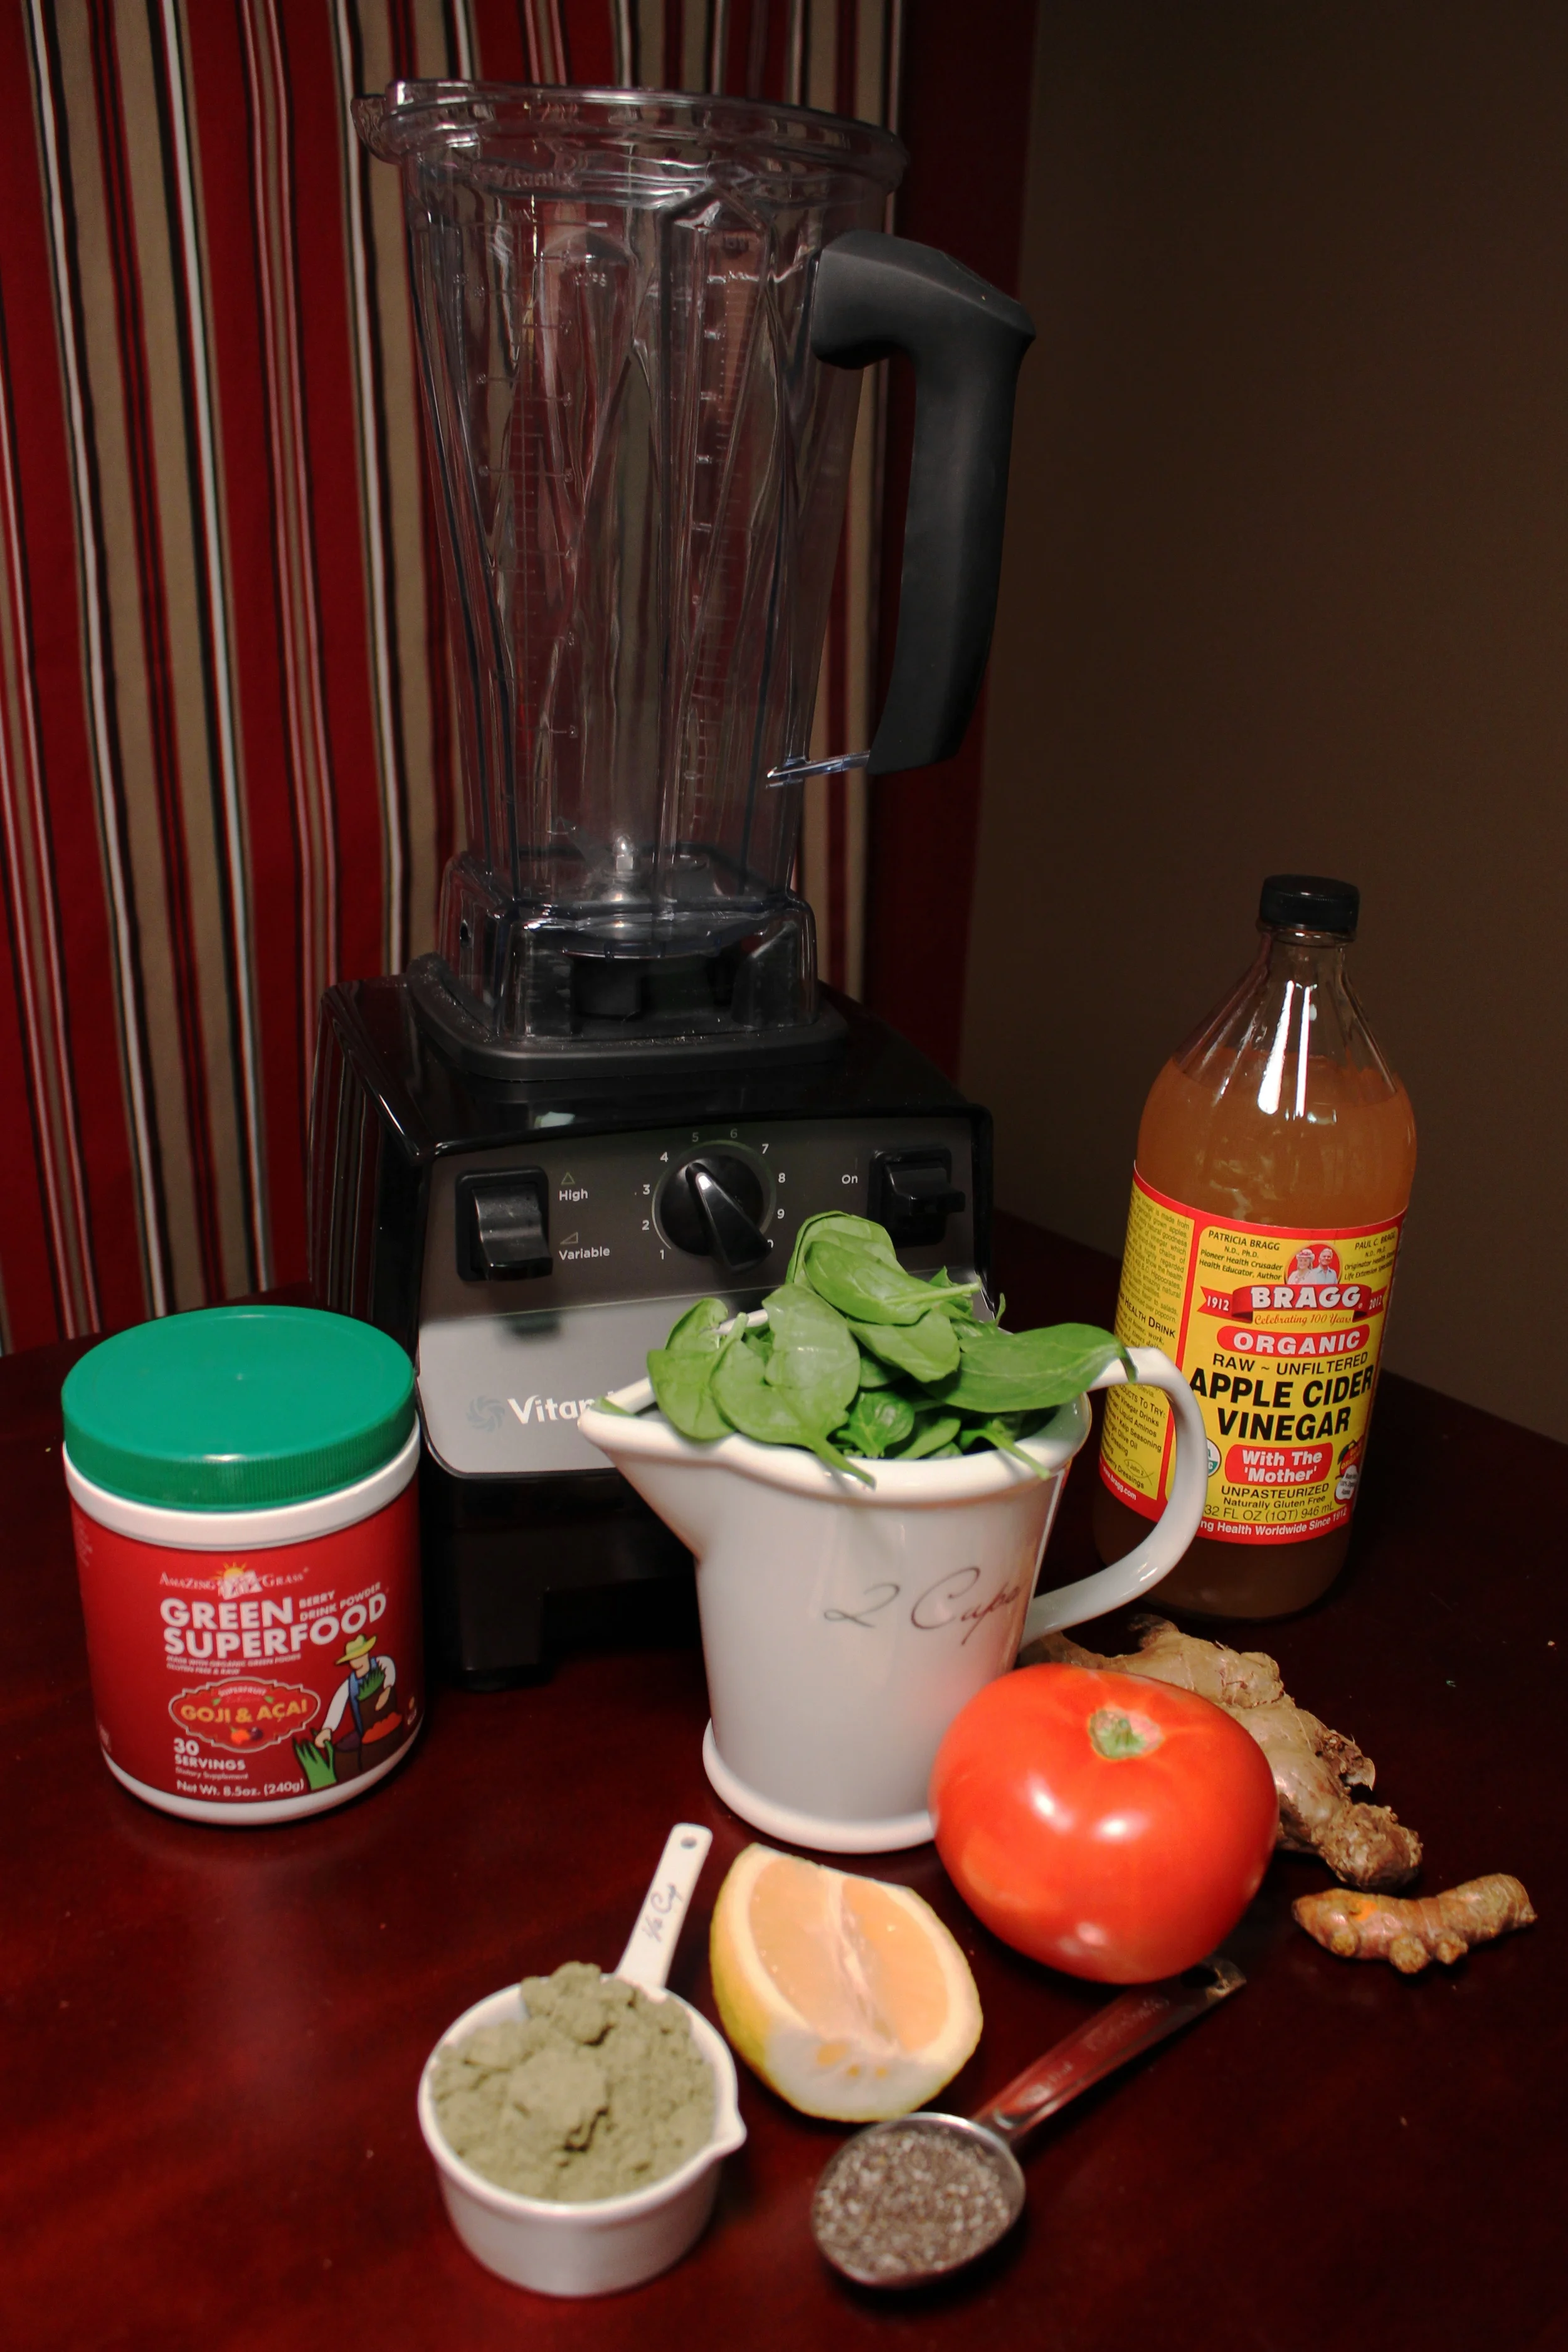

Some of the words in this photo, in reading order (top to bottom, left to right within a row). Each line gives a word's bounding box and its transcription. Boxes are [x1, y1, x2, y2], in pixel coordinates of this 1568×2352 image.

[692, 1132, 699, 1142] 5
[730, 1128, 738, 1138] 6
[660, 1152, 669, 1162] 4
[761, 1144, 770, 1154] 7
[778, 1173, 786, 1183] 8
[842, 1175, 858, 1184] On
[559, 1188, 588, 1202] High
[642, 1185, 650, 1195] 3
[777, 1209, 785, 1219] 9
[1162, 1212, 1175, 1223] made
[1177, 1219, 1190, 1229] from
[642, 1220, 650, 1231] 2
[1162, 1231, 1187, 1248] goodness
[1208, 1230, 1247, 1246] PATRICIA
[1249, 1239, 1281, 1251] BRAGG
[1355, 1241, 1372, 1250] PAUL
[559, 1246, 610, 1261] Variable
[660, 1249, 665, 1260] 1
[1159, 1248, 1175, 1261] chains
[1170, 1244, 1186, 1255] which
[1241, 1249, 1259, 1258] Ph.D.
[1160, 1258, 1184, 1273] regarded
[1200, 1249, 1225, 1260] Pioneer
[1226, 1256, 1249, 1266] Health
[1251, 1261, 1283, 1271] Crusader
[1344, 1259, 1372, 1271] Originator
[1166, 1269, 1183, 1281] health
[1199, 1259, 1221, 1270] Health
[1222, 1265, 1255, 1278] Educator,
[1257, 1272, 1282, 1280] Author
[1344, 1273, 1353, 1281] Life
[1162, 1286, 1181, 1299] natural
[1207, 1295, 1229, 1311] 1912
[1251, 1286, 1361, 1308] BRAGG
[1369, 1295, 1383, 1310] 2012
[1125, 1297, 1146, 1323] HEALTH
[1148, 1316, 1176, 1339] DRINK
[1254, 1313, 1308, 1325] Celebrating
[1310, 1313, 1327, 1323] 100
[1329, 1313, 1352, 1325] Years
[1233, 1330, 1360, 1355] ORGANIC
[1213, 1353, 1255, 1372] RAW
[1276, 1351, 1369, 1375] UNFILTERED
[1189, 1367, 1294, 1408] APPLE
[1302, 1364, 1374, 1408] CIDER
[1120, 1397, 1138, 1416] Vinegar
[1139, 1411, 1160, 1428] Drinks
[1119, 1406, 1133, 1424] Liquid
[1134, 1421, 1157, 1438] Aminos
[1217, 1406, 1351, 1441] VINEGAR
[1119, 1418, 1130, 1433] Kelp
[1130, 1428, 1162, 1454] Seasoning
[1130, 1439, 1138, 1451] Oil
[1242, 1449, 1285, 1466] With
[1291, 1451, 1322, 1466] The
[1117, 1464, 1145, 1489] Dressings
[1244, 1465, 1316, 1483] 'Mother'
[1221, 1483, 1329, 1499] UNPASTEURIZED
[1224, 1497, 1271, 1510] Naturally
[1273, 1500, 1305, 1508] Gluten
[1307, 1495, 1326, 1505] Free
[1204, 1505, 1219, 1517] 32
[1223, 1508, 1238, 1520] FL
[1242, 1510, 1261, 1521] OZ
[1265, 1510, 1298, 1522] (1QT)
[1301, 1505, 1320, 1519] 946
[1321, 1501, 1334, 1513] mL
[1217, 1522, 1251, 1535] Health
[1255, 1523, 1306, 1535] Worldwide
[1309, 1517, 1330, 1530] Since
[1333, 1510, 1347, 1522] 1912
[160, 1597, 293, 1629] GREEN
[299, 1590, 336, 1609] BERRY
[300, 1604, 337, 1623] DRINK
[339, 1582, 381, 1610] POWDER
[824, 1582, 900, 1628] 2
[911, 1566, 1020, 1646] Cups
[163, 1592, 386, 1659] SUPERFOOD
[181, 1704, 231, 1723] GOJI
[235, 1707, 252, 1723] &
[257, 1698, 308, 1722] AÇAI
[173, 1738, 199, 1756] 30
[174, 1754, 246, 1771] SERVINGS
[203, 1771, 249, 1781] Supplement
[176, 1779, 198, 1793] Net
[199, 1784, 220, 1796] Wt.
[263, 1779, 305, 1796] (240g)
